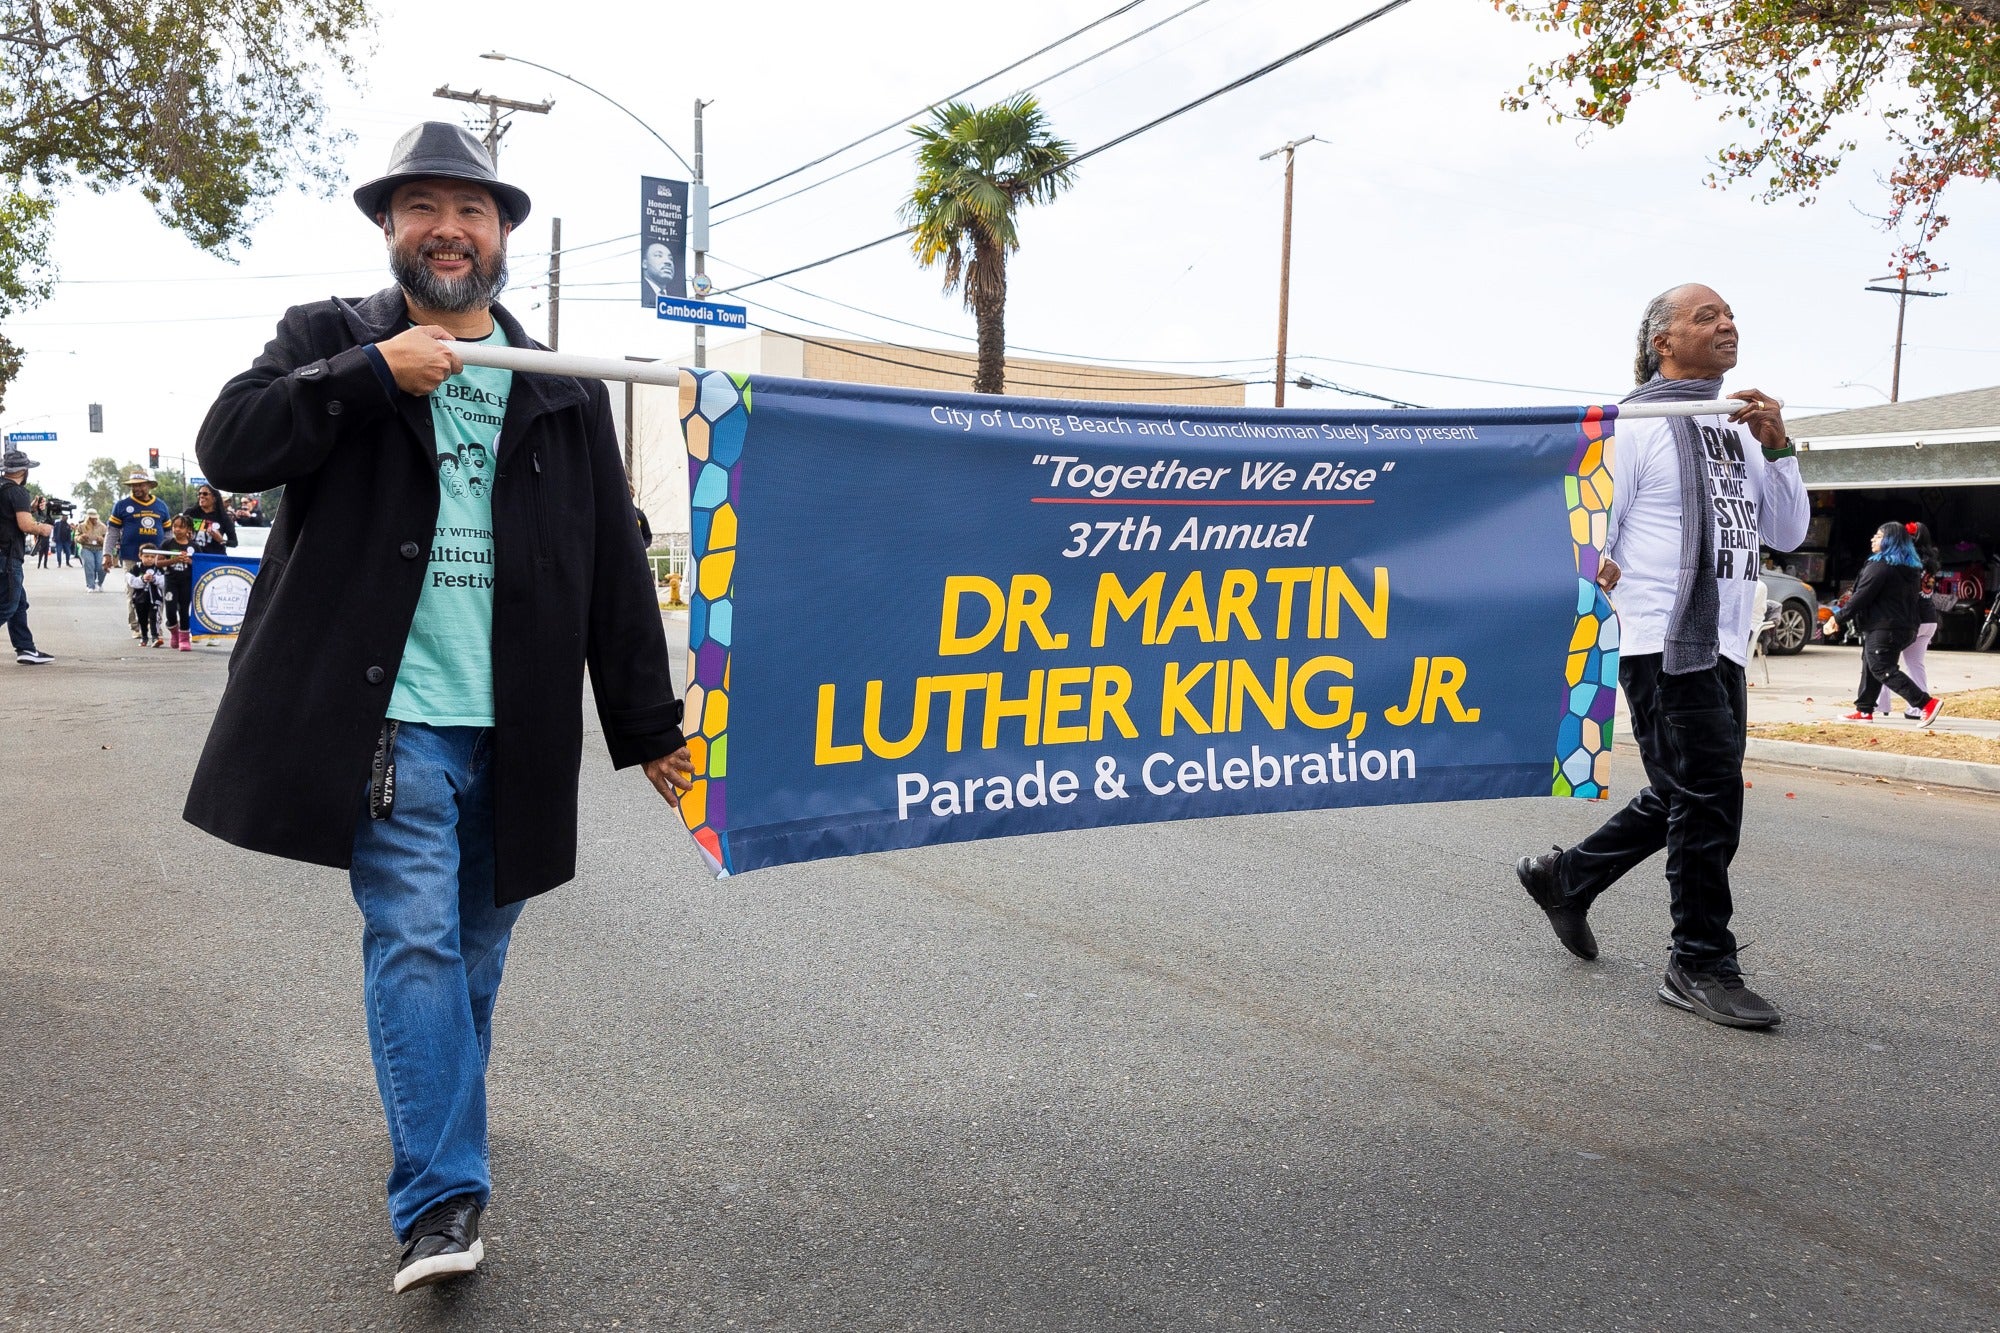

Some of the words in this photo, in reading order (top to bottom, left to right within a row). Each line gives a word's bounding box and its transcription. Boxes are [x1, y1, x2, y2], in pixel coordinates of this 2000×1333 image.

[646, 207, 657, 216] Dr.
[659, 209, 682, 219] Martin
[648, 199, 681, 212] Honoring
[650, 225, 668, 236] King,
[669, 228, 678, 236] Jr.
[652, 217, 675, 227] Luther
[659, 302, 713, 320] Cambodia
[716, 308, 745, 324] Town
[445, 383, 508, 408] BEACH
[455, 407, 504, 426] Comm
[931, 406, 973, 431] City
[980, 410, 1003, 427] of
[1008, 412, 1065, 436] Long
[1067, 415, 1132, 434] Beach
[1137, 419, 1176, 437] and
[1180, 421, 1319, 440] Councilwoman
[1321, 424, 1369, 444] Suely
[1372, 425, 1411, 440] Saro
[1414, 426, 1479, 444] present
[1032, 454, 1230, 498] "Together
[1239, 461, 1296, 491] We
[1302, 460, 1395, 492] Rise"
[1719, 479, 1744, 498] MAKE
[1713, 497, 1757, 531] STIC
[449, 528, 494, 539] WITHIN
[1062, 516, 1162, 558] 37th
[1168, 514, 1315, 552] Annual
[1720, 529, 1757, 550] REALITY
[939, 574, 1068, 656] DR.
[1091, 566, 1389, 647] MARTIN
[814, 666, 1139, 765] LUTHER
[1161, 657, 1367, 740] KING,
[1384, 657, 1481, 727] JR.
[897, 760, 1079, 821] Parade
[1093, 755, 1130, 801] &
[1142, 740, 1416, 796] Celebration
